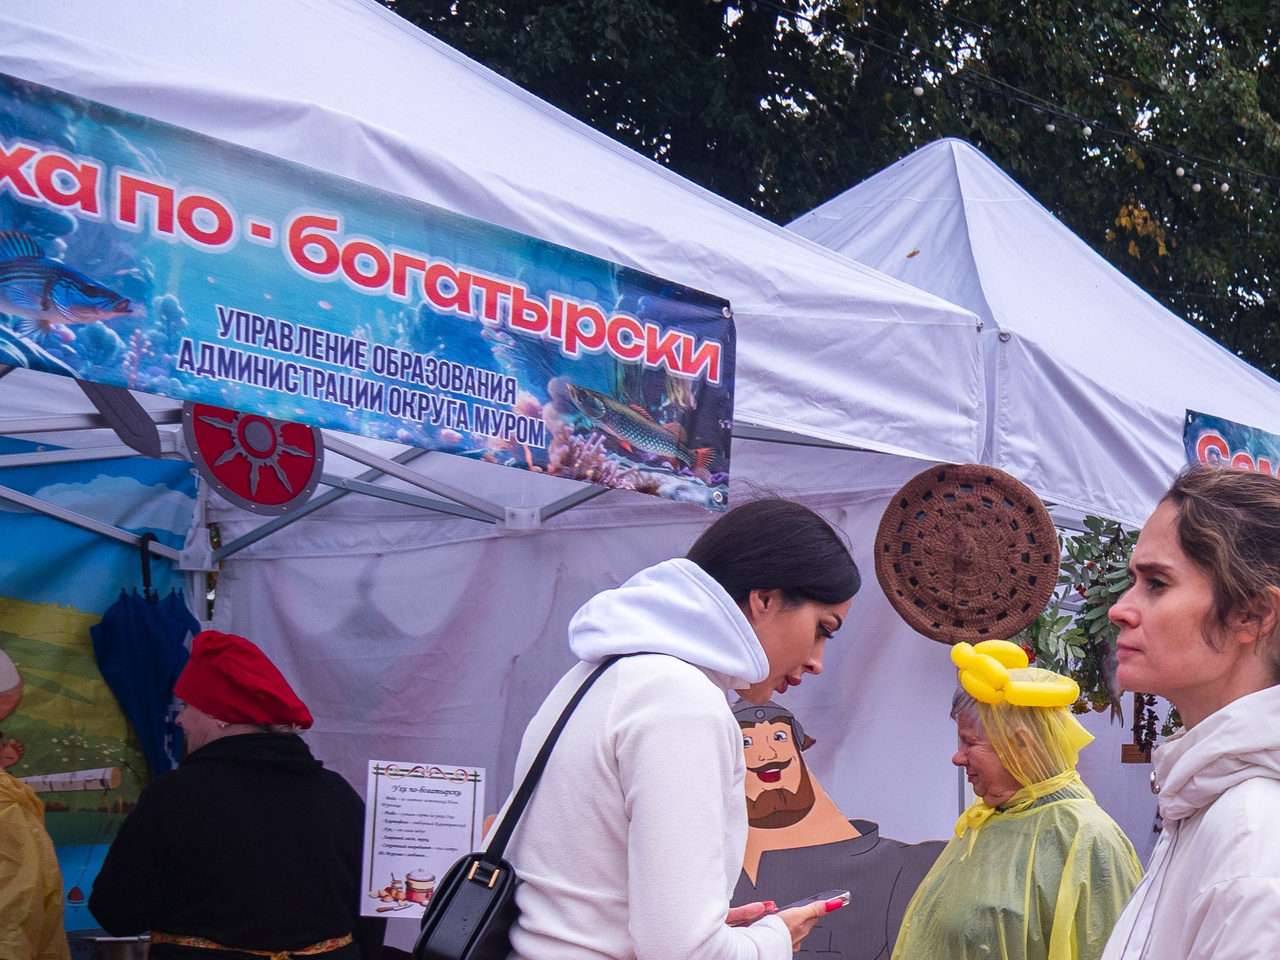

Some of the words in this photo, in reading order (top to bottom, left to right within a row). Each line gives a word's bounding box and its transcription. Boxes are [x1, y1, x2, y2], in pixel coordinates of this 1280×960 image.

[119, 174, 234, 246] по
[288, 214, 721, 382] богатырски
[178, 339, 384, 413] АДМИНИСТРАЦИИ
[388, 386, 469, 431] ОКРУГА
[474, 404, 545, 448] МУРОМ
[217, 305, 367, 371] УПРАВЛЕНИЕ
[372, 345, 517, 406] ОБРАЗОВАНИЯ
